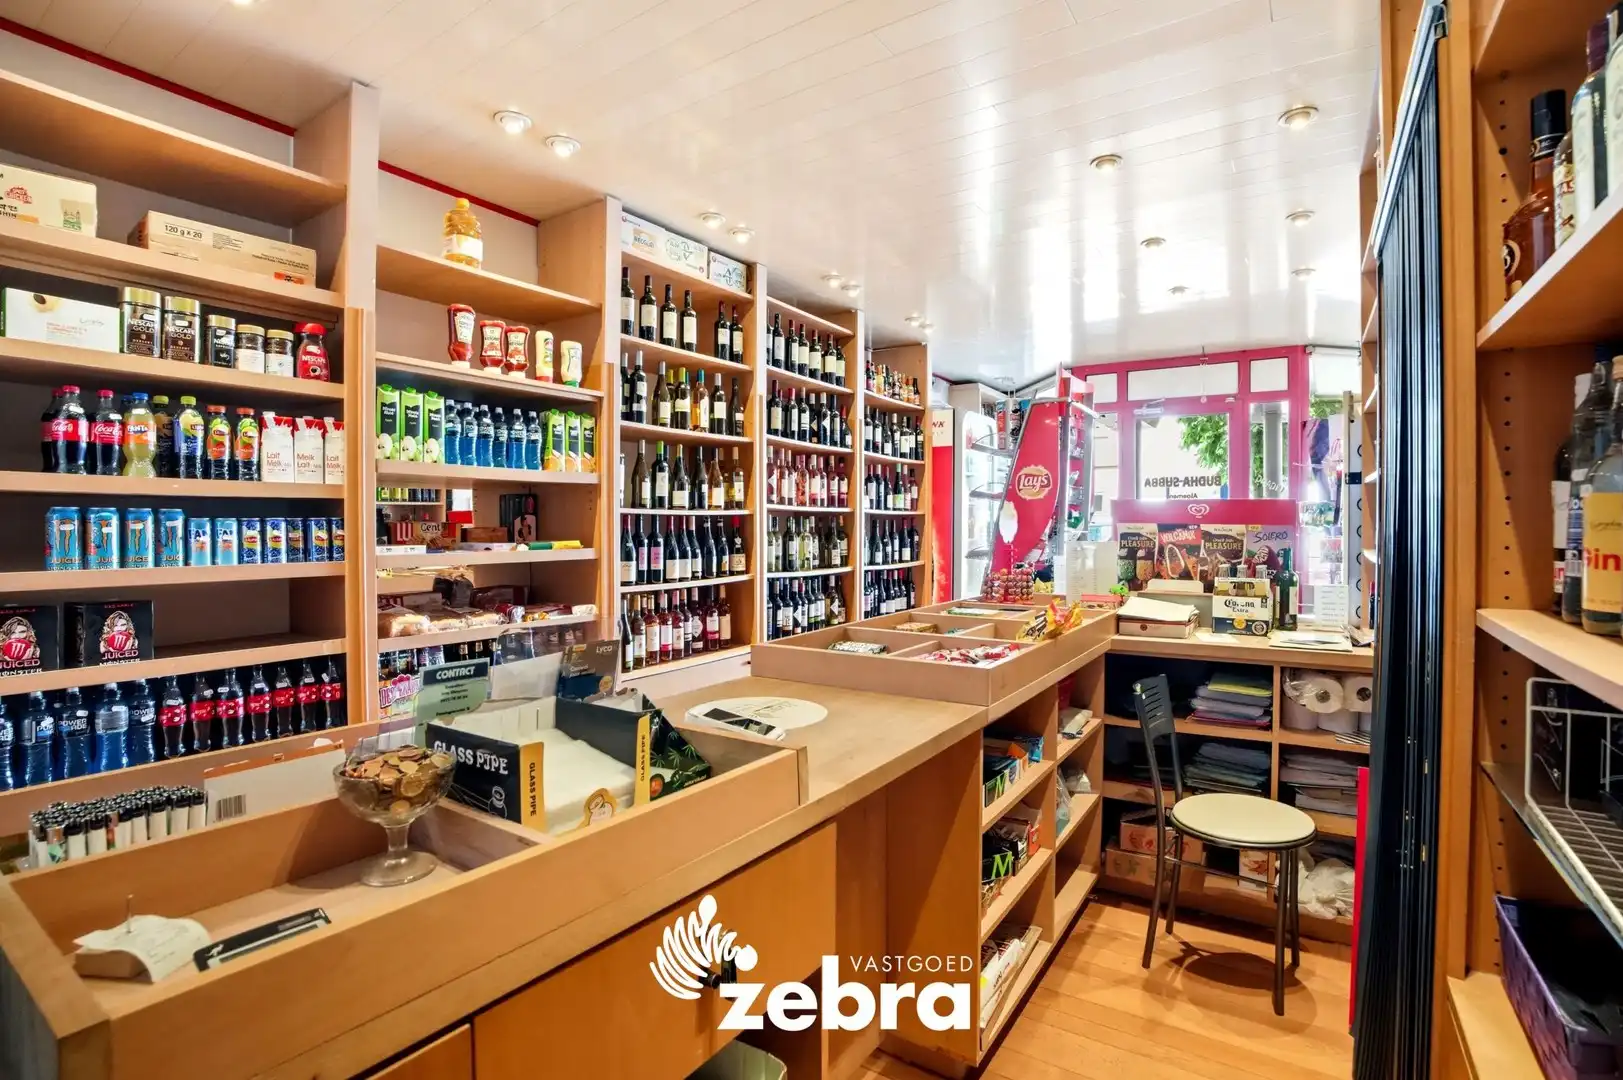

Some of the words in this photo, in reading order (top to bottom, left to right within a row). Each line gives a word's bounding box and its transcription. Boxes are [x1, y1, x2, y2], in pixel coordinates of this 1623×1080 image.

[165, 225, 178, 234] 120
[180, 229, 185, 237] g
[193, 230, 202, 239] 20
[133, 326, 155, 334] GOLD
[171, 332, 192, 340] GOLD
[1120, 540, 1154, 548] PLEASURE
[1205, 542, 1243, 550] PLEASURE
[102, 650, 139, 660] JUICED
[436, 666, 475, 680] CONTACT
[529, 762, 537, 794] GLASS
[529, 795, 538, 817] PIPE
